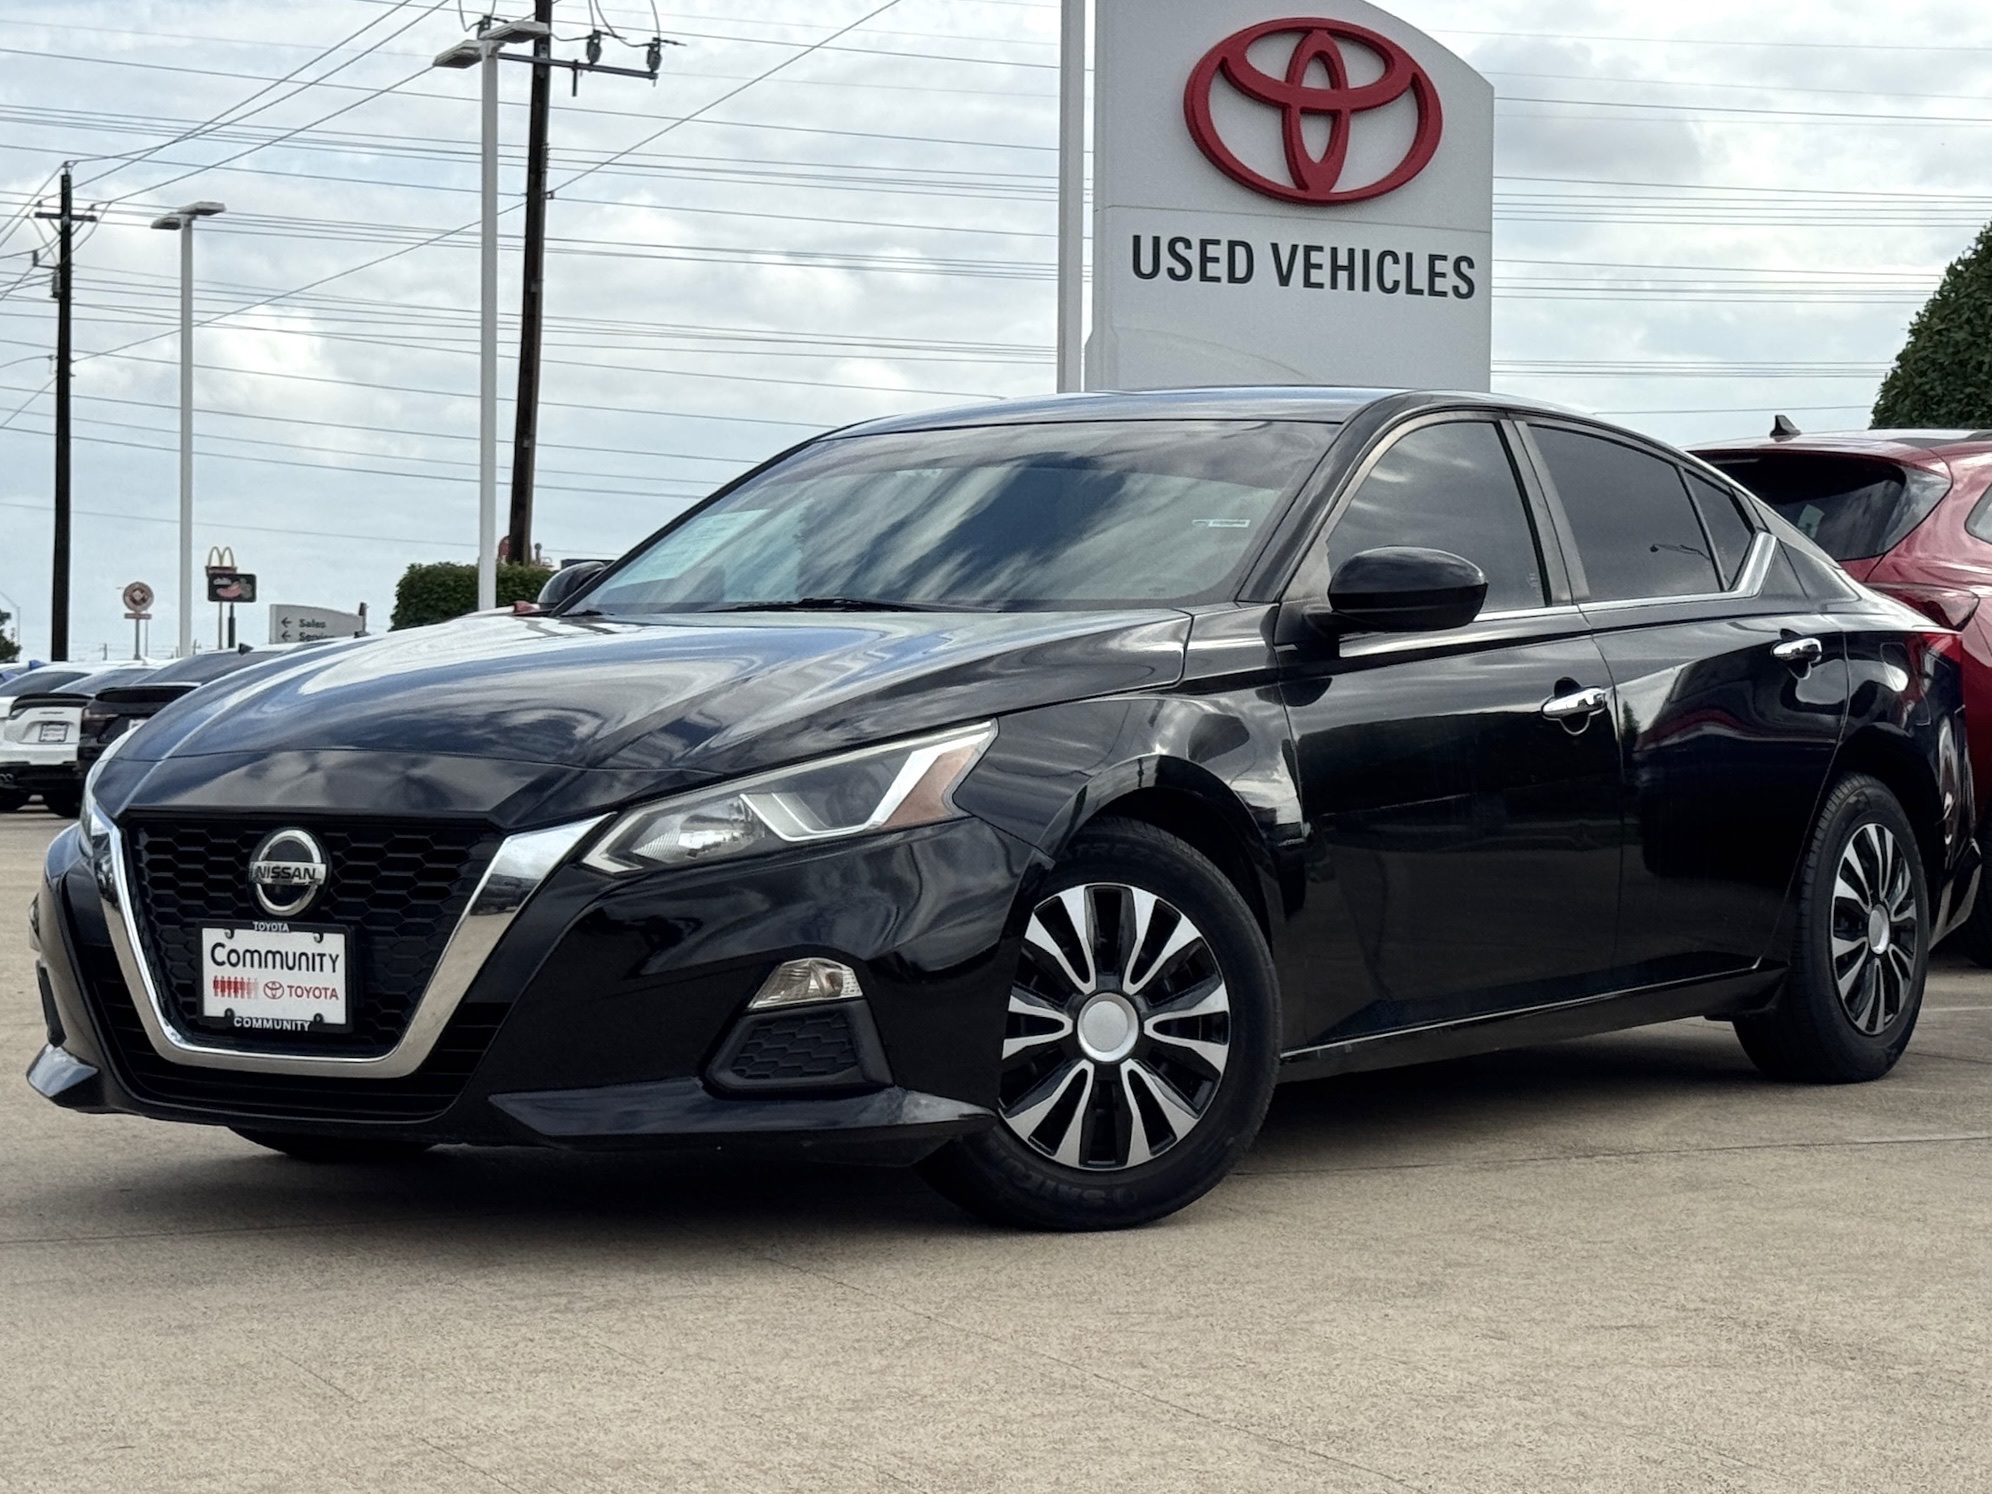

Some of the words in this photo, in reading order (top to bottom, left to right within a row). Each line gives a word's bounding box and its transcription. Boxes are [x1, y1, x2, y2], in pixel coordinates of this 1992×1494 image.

[1132, 234, 1254, 284] USED
[1270, 242, 1475, 300] VEHICLES
[299, 618, 326, 628] Sales
[254, 865, 317, 881] NISSAN
[252, 921, 290, 933] TOYOTA
[286, 984, 340, 1001] TOYOTA
[233, 1016, 311, 1032] COMMUNITY
